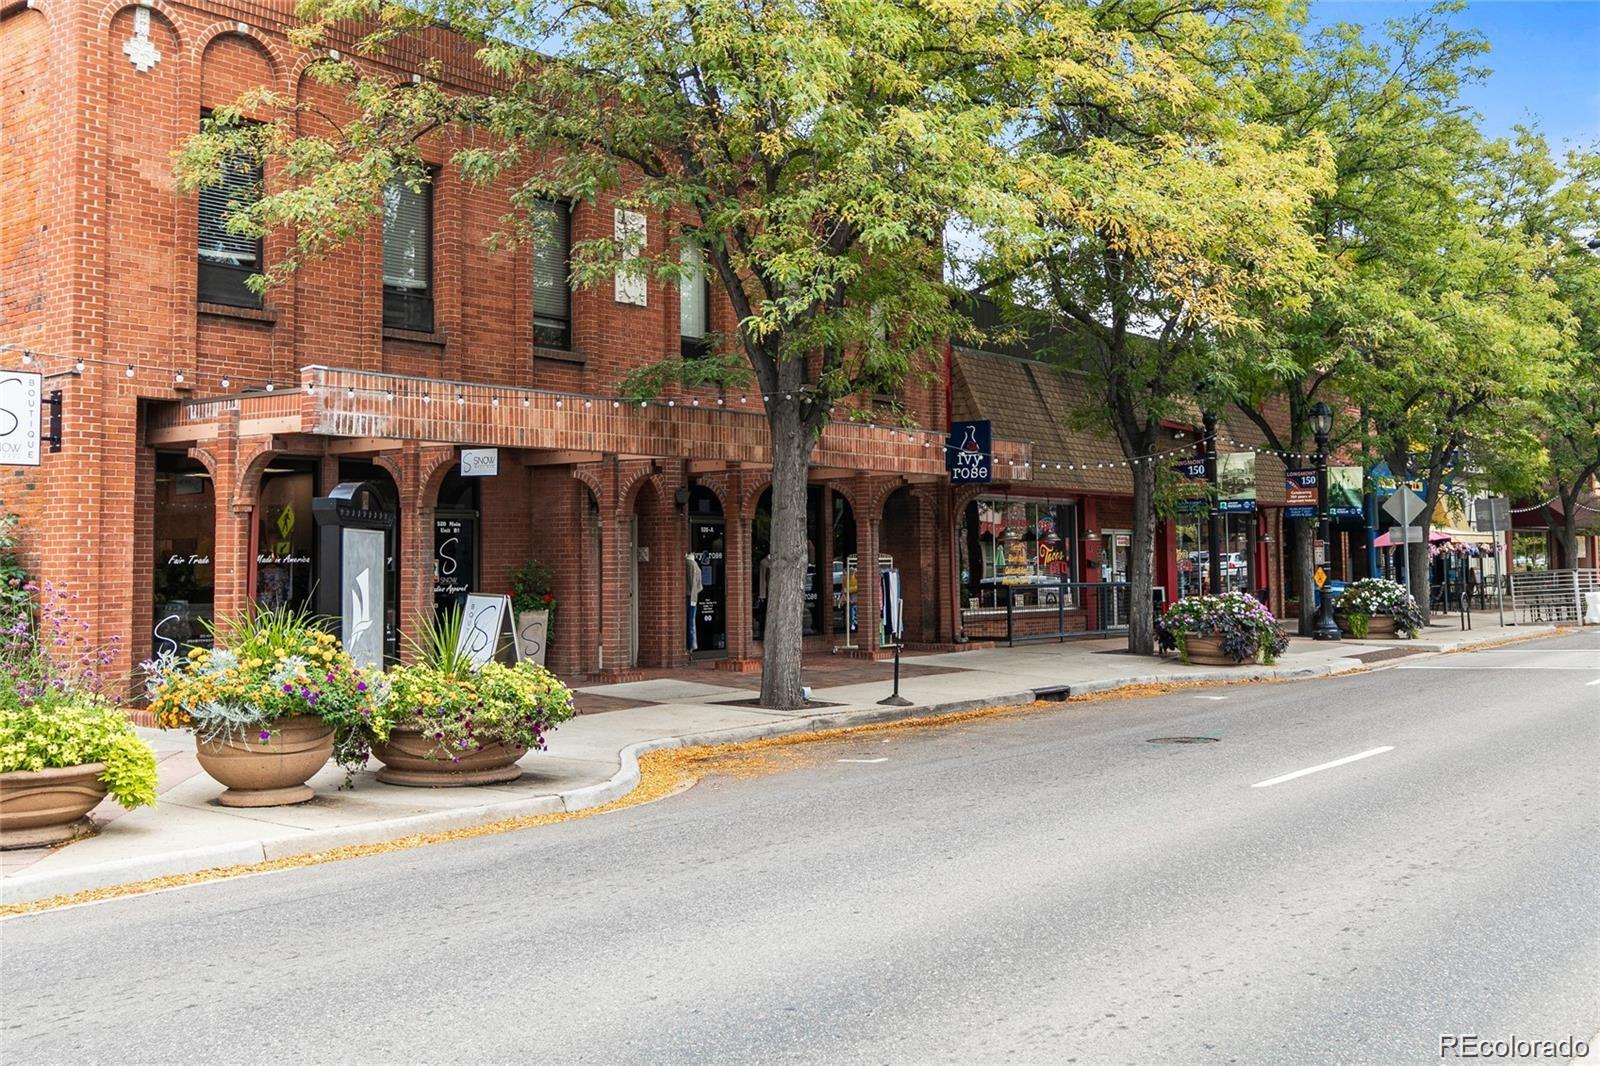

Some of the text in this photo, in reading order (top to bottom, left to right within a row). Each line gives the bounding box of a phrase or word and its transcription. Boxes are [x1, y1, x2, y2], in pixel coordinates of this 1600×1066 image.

[27, 379, 36, 458] BOUTIQUE
[473, 456, 496, 465] SNOW
[957, 452, 983, 468] ivy
[952, 466, 988, 479] rose
[1188, 465, 1205, 475] 150
[1301, 476, 1316, 485] 150
[168, 555, 210, 565] Fair Trade
[282, 554, 311, 563] America
[1040, 543, 1064, 568] Tacos
[445, 584, 469, 594] Apparel
